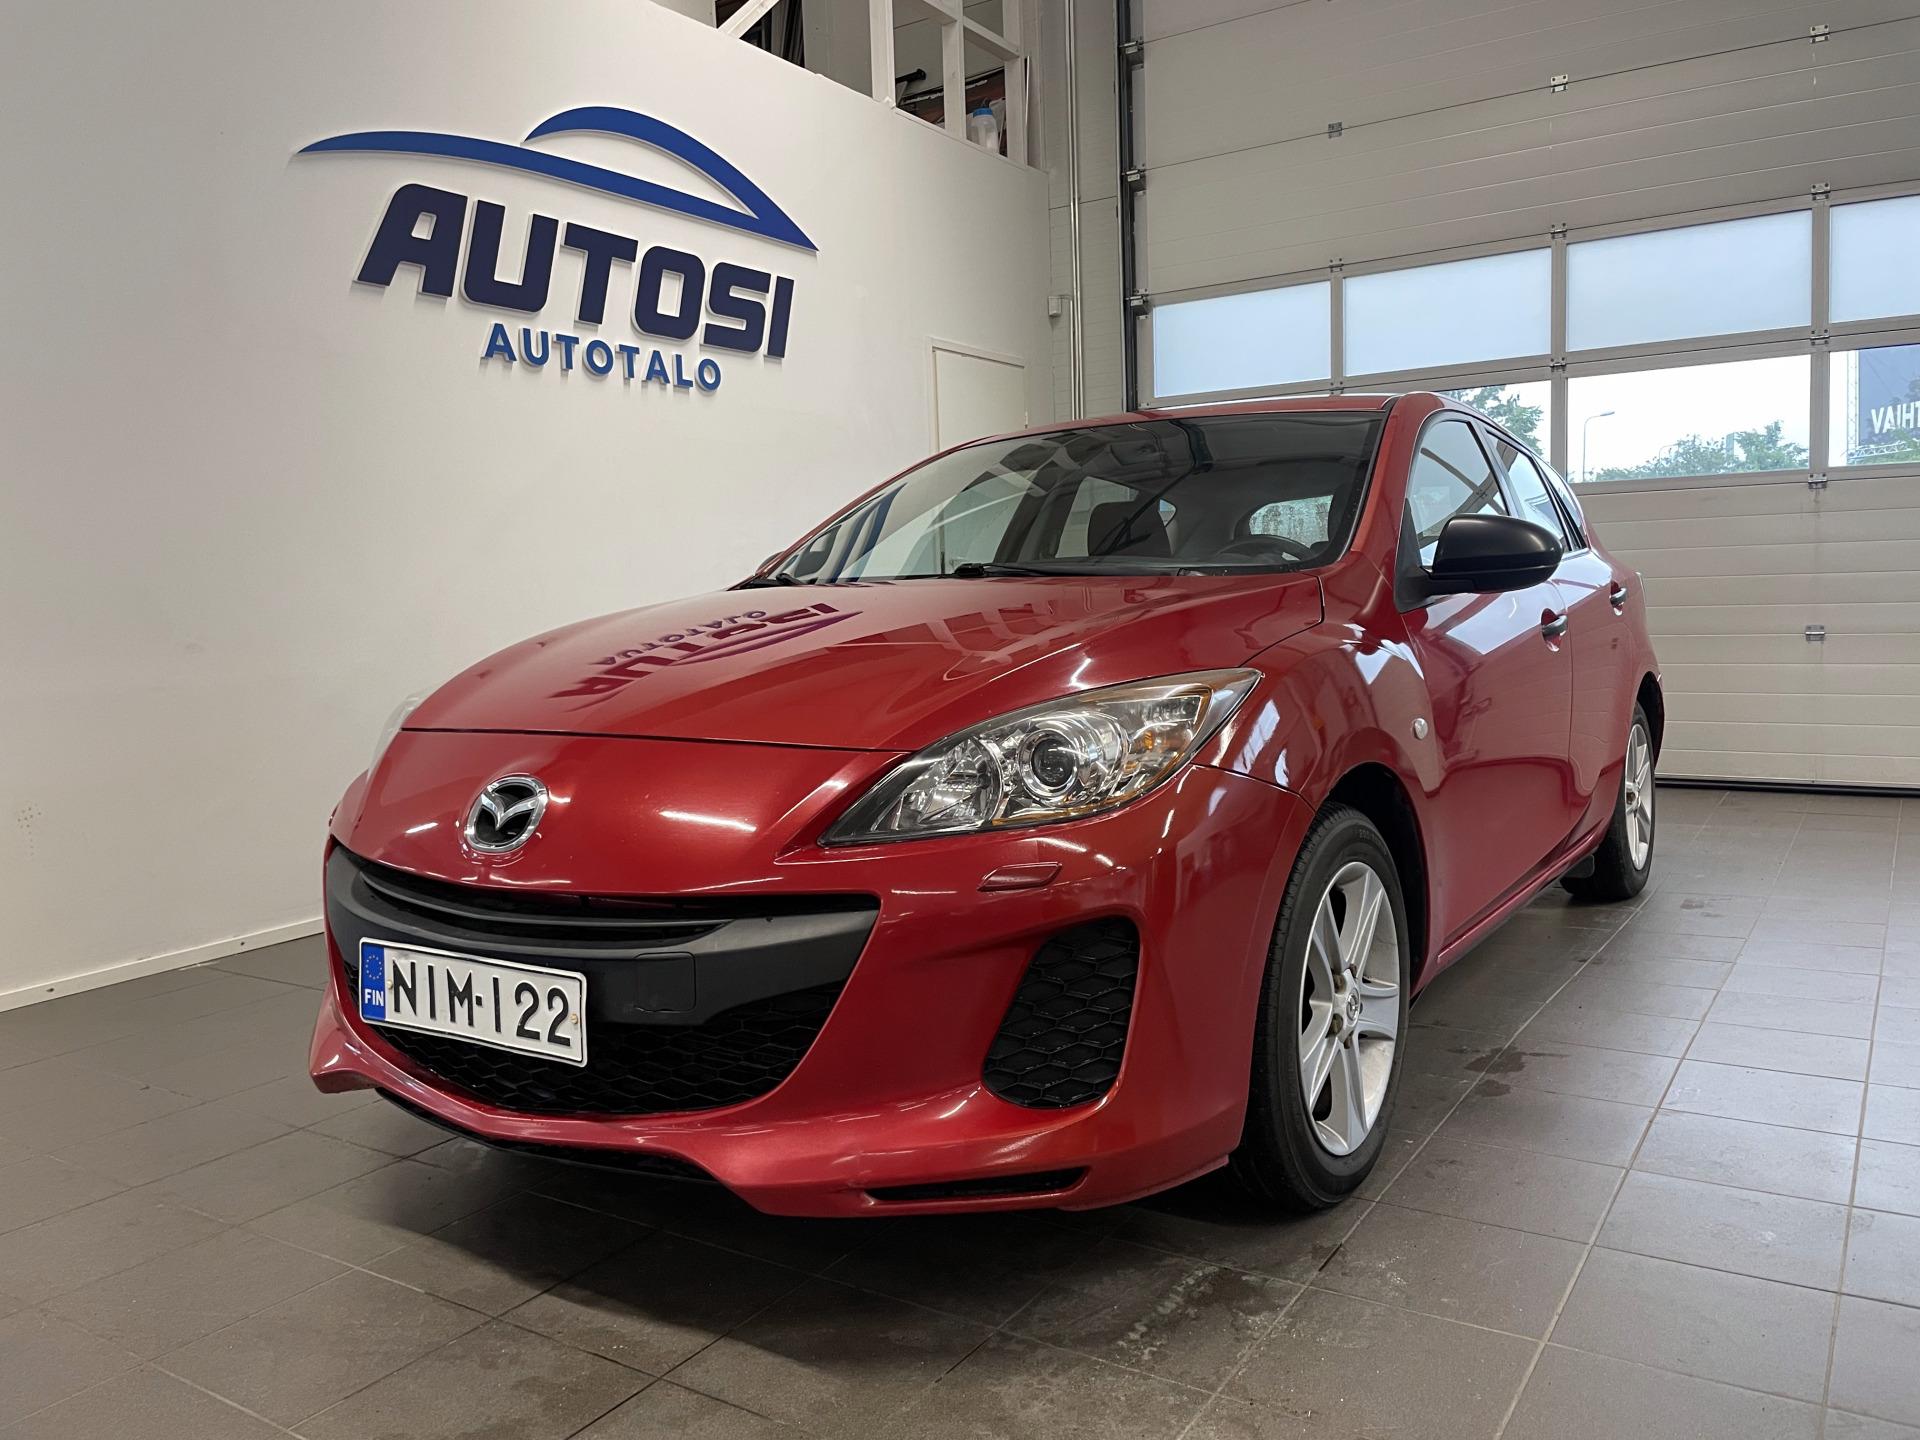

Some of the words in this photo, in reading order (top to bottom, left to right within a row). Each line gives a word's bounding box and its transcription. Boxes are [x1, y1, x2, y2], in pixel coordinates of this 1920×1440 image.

[355, 183, 795, 358] AUTOSI
[482, 322, 722, 392] AUTOTALO
[364, 989, 384, 1007] FIN
[392, 959, 571, 1047] NIM-122
